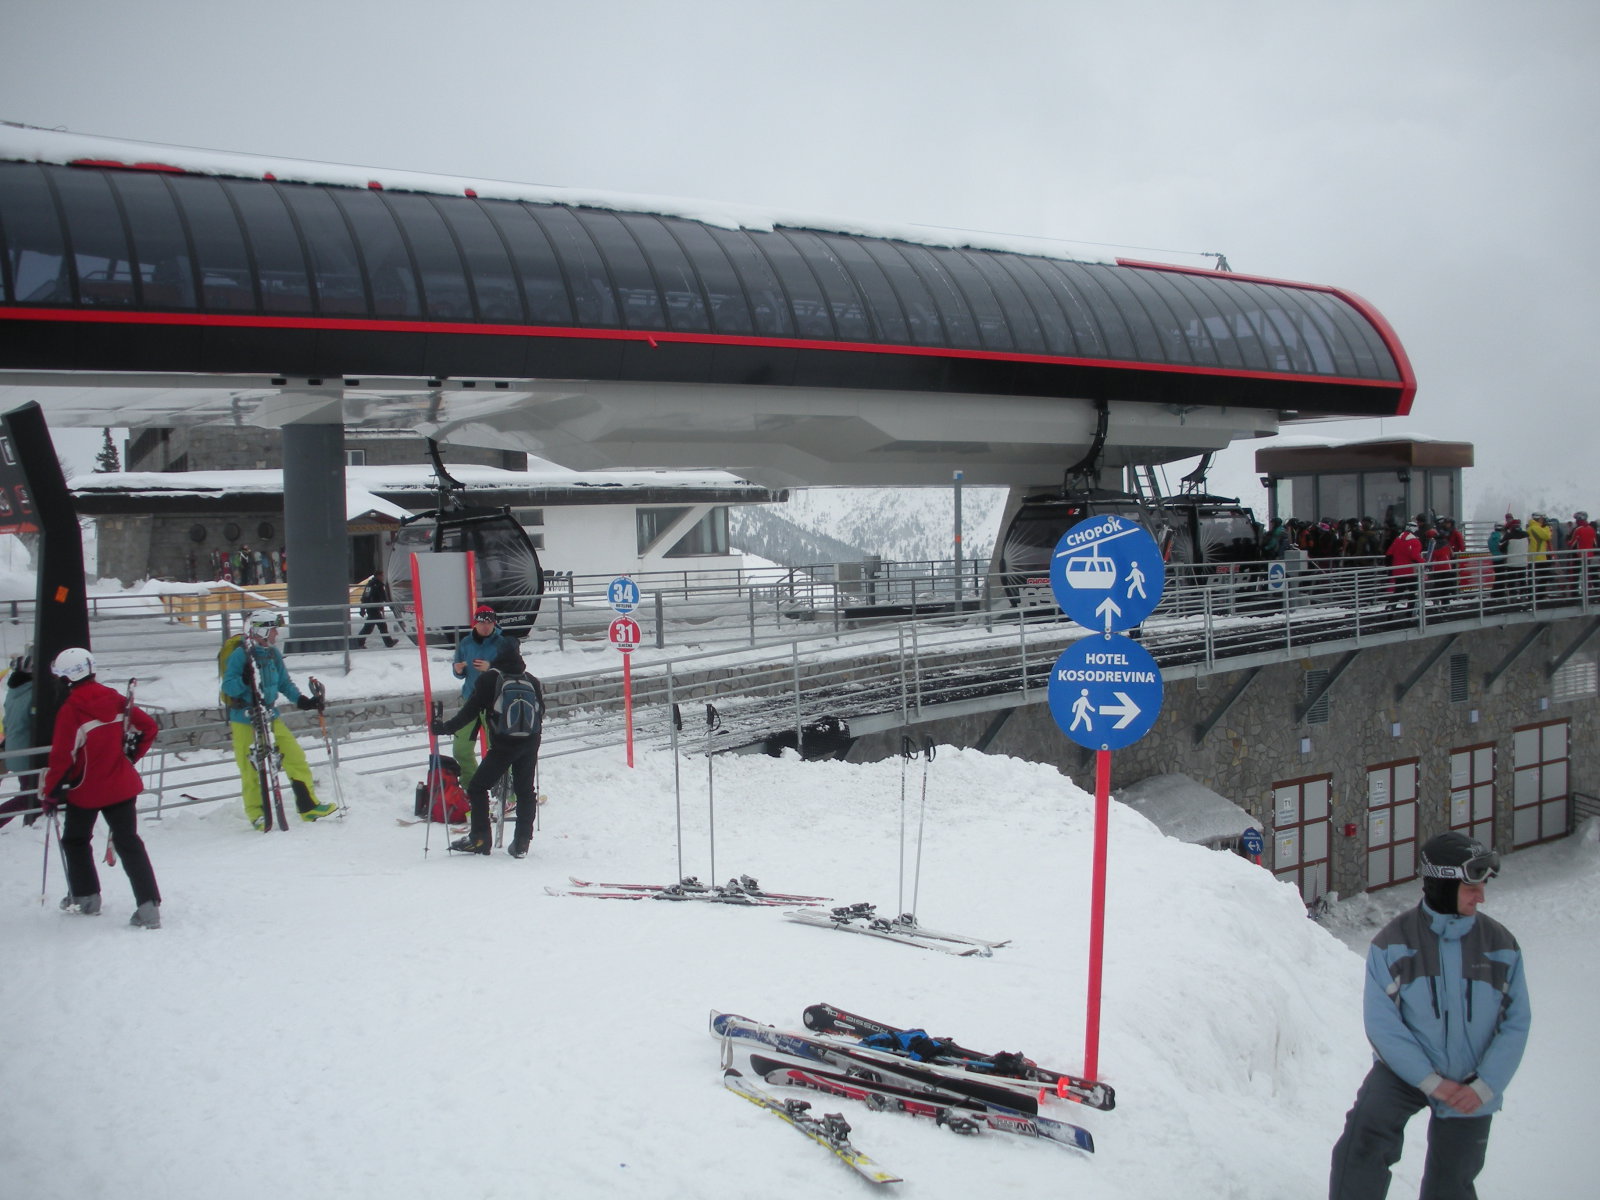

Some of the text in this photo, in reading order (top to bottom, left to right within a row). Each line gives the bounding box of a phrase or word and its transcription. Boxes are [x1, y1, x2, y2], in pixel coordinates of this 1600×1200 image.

[1066, 519, 1123, 546] CHOPOK
[613, 583, 634, 603] 34
[615, 623, 634, 643] 31
[1085, 653, 1129, 665] HOTEL
[1058, 669, 1155, 683] KOSODREVINA
